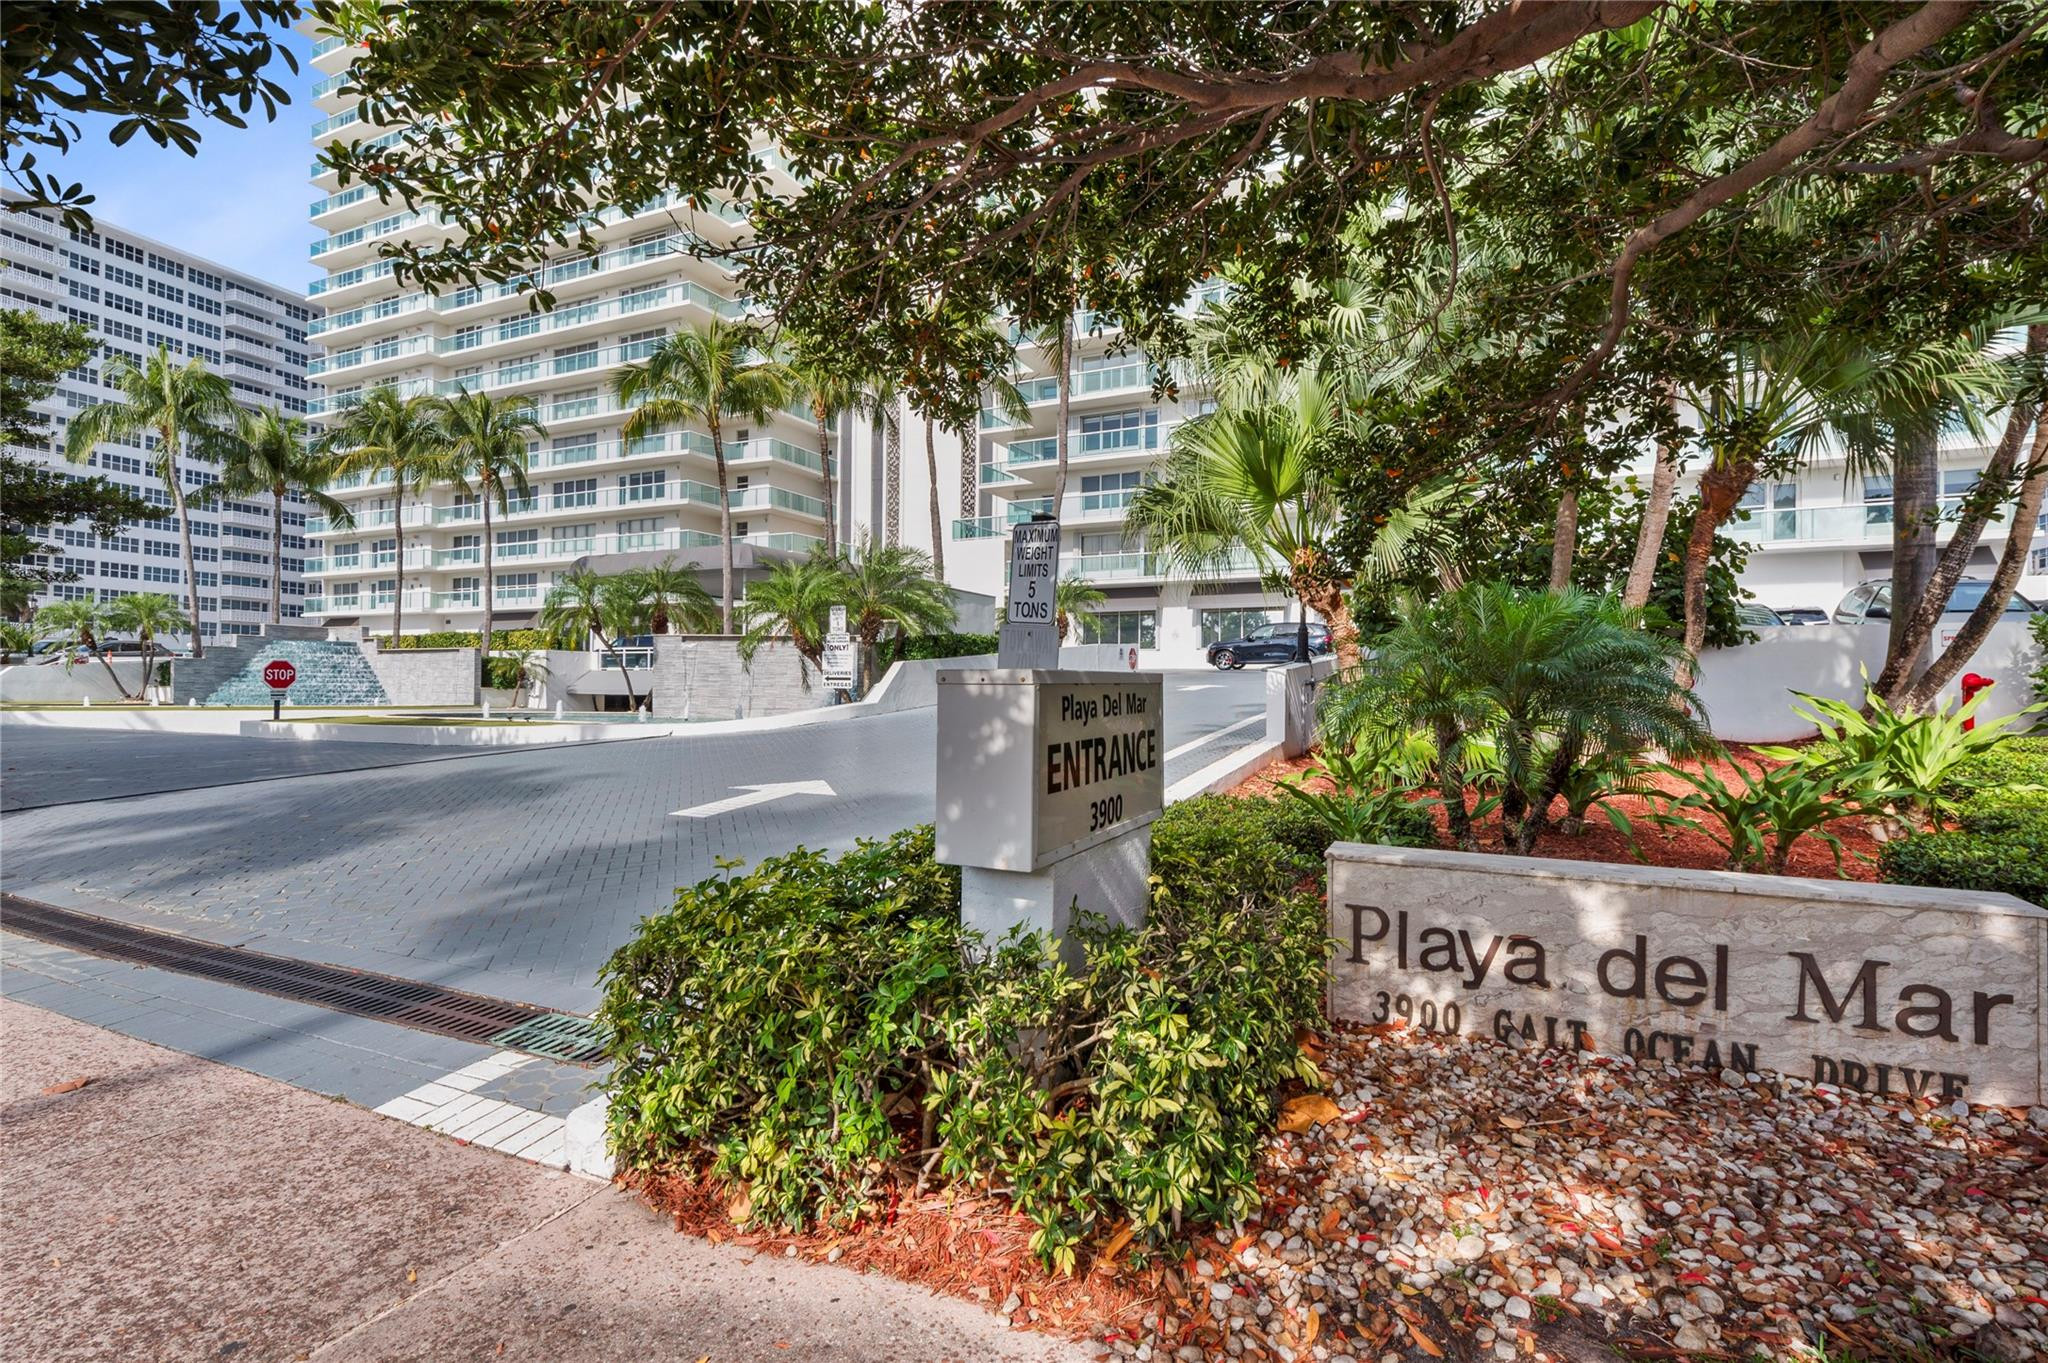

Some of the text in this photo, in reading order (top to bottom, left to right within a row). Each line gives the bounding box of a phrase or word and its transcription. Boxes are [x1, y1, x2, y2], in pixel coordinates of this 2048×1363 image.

[1014, 528, 1058, 543] MAXIMUM
[1017, 546, 1054, 560] WEIGHT
[1018, 563, 1048, 577] LIMITS
[1028, 581, 1035, 598] 5
[1014, 602, 1047, 618] TONS
[265, 669, 294, 680] STOP
[1061, 691, 1147, 727] Playa Del Mar
[1047, 729, 1156, 795] ENTRANCE
[1090, 794, 1123, 832] 3900
[1345, 903, 2014, 1045] Playa del Mar
[1372, 990, 1461, 1035] 3900
[1623, 1027, 1760, 1073] OCEAN
[1811, 1054, 1970, 1099] DRIVE
